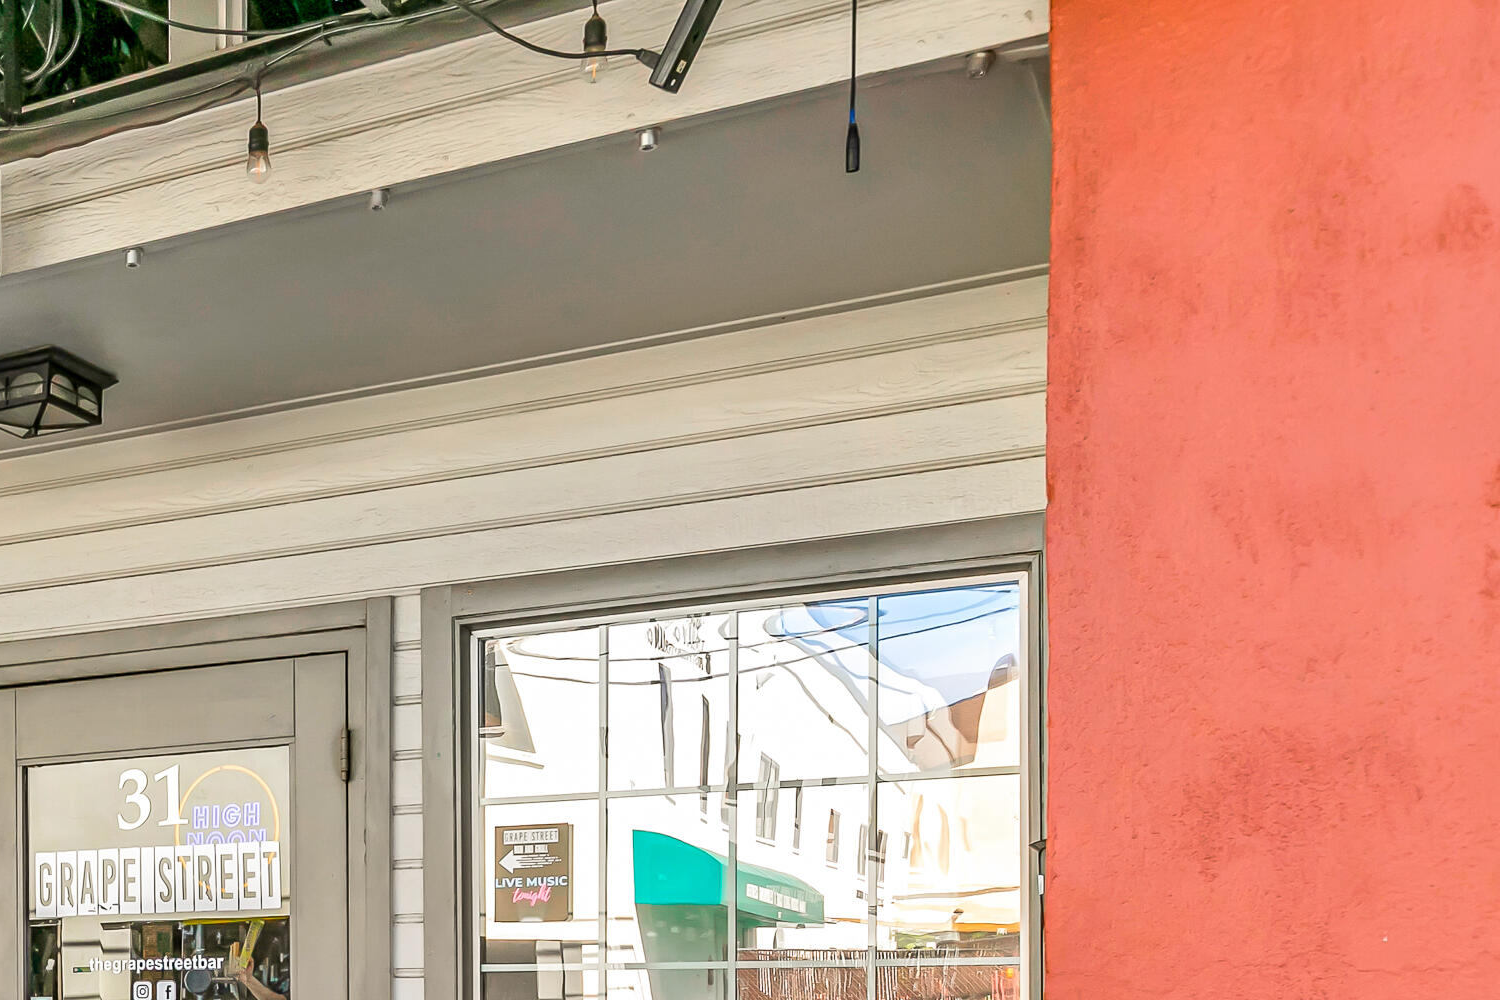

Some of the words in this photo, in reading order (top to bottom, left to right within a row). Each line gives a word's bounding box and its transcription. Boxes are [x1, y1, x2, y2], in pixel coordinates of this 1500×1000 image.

[117, 764, 188, 830] 31
[193, 802, 260, 829] HIGH
[504, 832, 528, 842] GRAPE
[531, 830, 558, 841] STREET
[39, 858, 136, 907] GRAPE
[159, 852, 277, 902] STREET
[495, 877, 523, 888] LIVE
[526, 876, 568, 888] MUSIC
[512, 884, 552, 906] tonight
[89, 955, 224, 974] thegrapestreetbar
